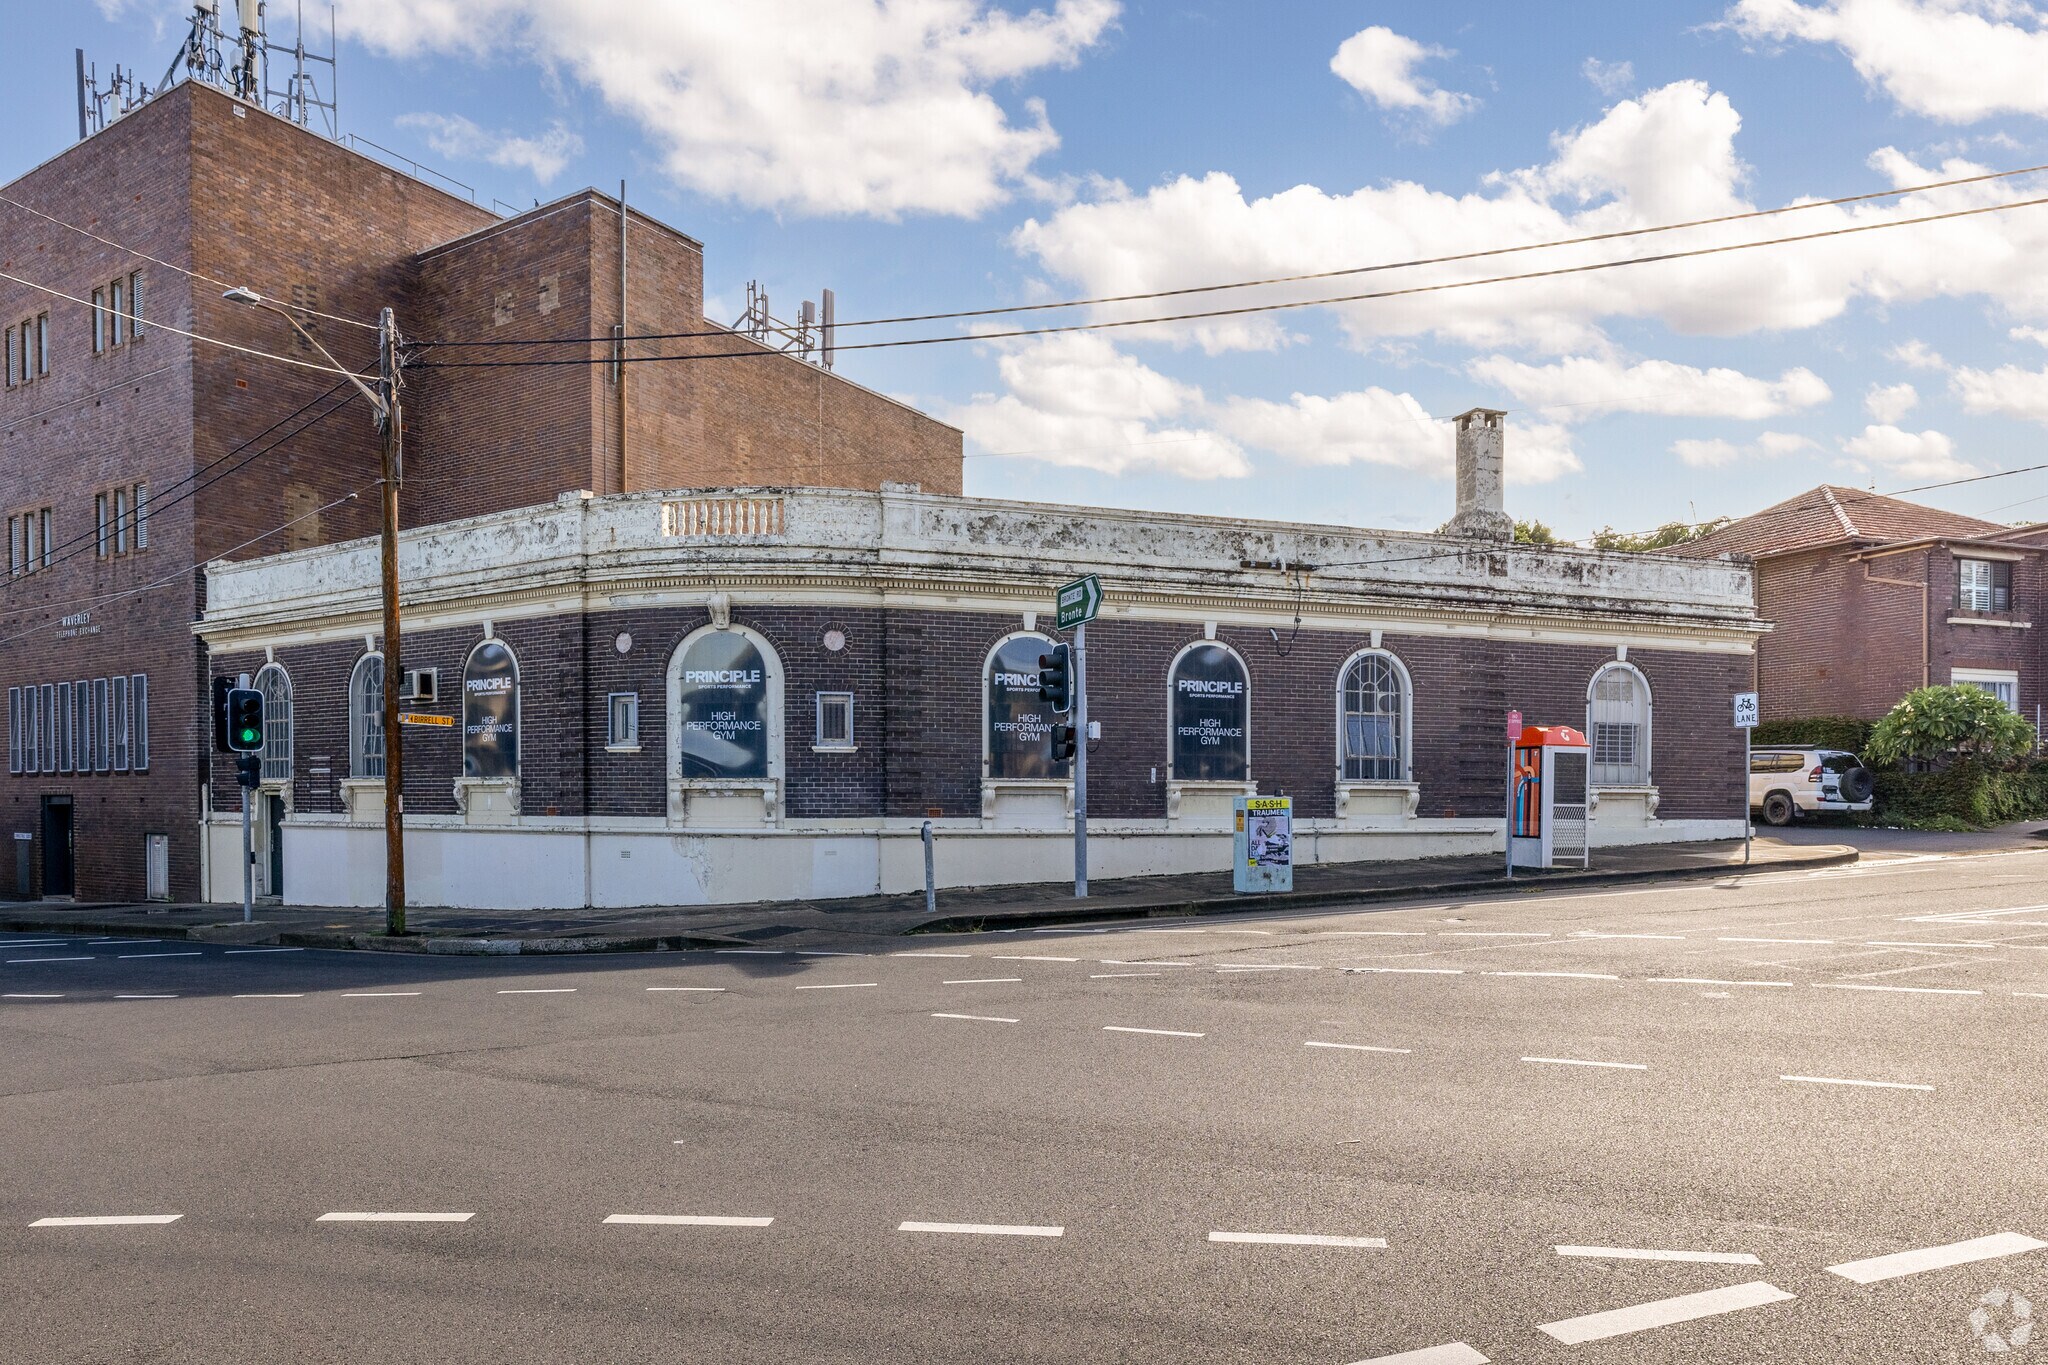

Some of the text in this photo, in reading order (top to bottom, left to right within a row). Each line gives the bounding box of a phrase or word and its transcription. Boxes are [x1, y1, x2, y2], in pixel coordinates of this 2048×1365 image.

[62, 612, 90, 627] WAVERLEY
[1061, 607, 1082, 623] Bronte
[685, 670, 760, 683] PRINCIPLE
[994, 673, 1040, 687] PRINCI
[466, 677, 511, 692] PRINCIPLE
[1178, 680, 1243, 693] PRINCIPLE
[414, 715, 439, 725] BIRRELL
[441, 717, 450, 725] ST
[481, 715, 498, 724] HIGH
[711, 711, 736, 721] HIGH
[1017, 713, 1041, 723] HIGH
[1736, 713, 1756, 723] LANE
[686, 721, 761, 730] PERFORMANCE
[994, 722, 1056, 733] PERFORMAN
[1199, 718, 1221, 727] HIGH
[467, 723, 513, 734] PERFORMANCE
[1178, 726, 1242, 737] PERFORMANCE
[482, 733, 497, 742] GYM
[712, 730, 736, 740] GYM
[1019, 732, 1040, 742] GYM
[1200, 736, 1220, 745] GYM
